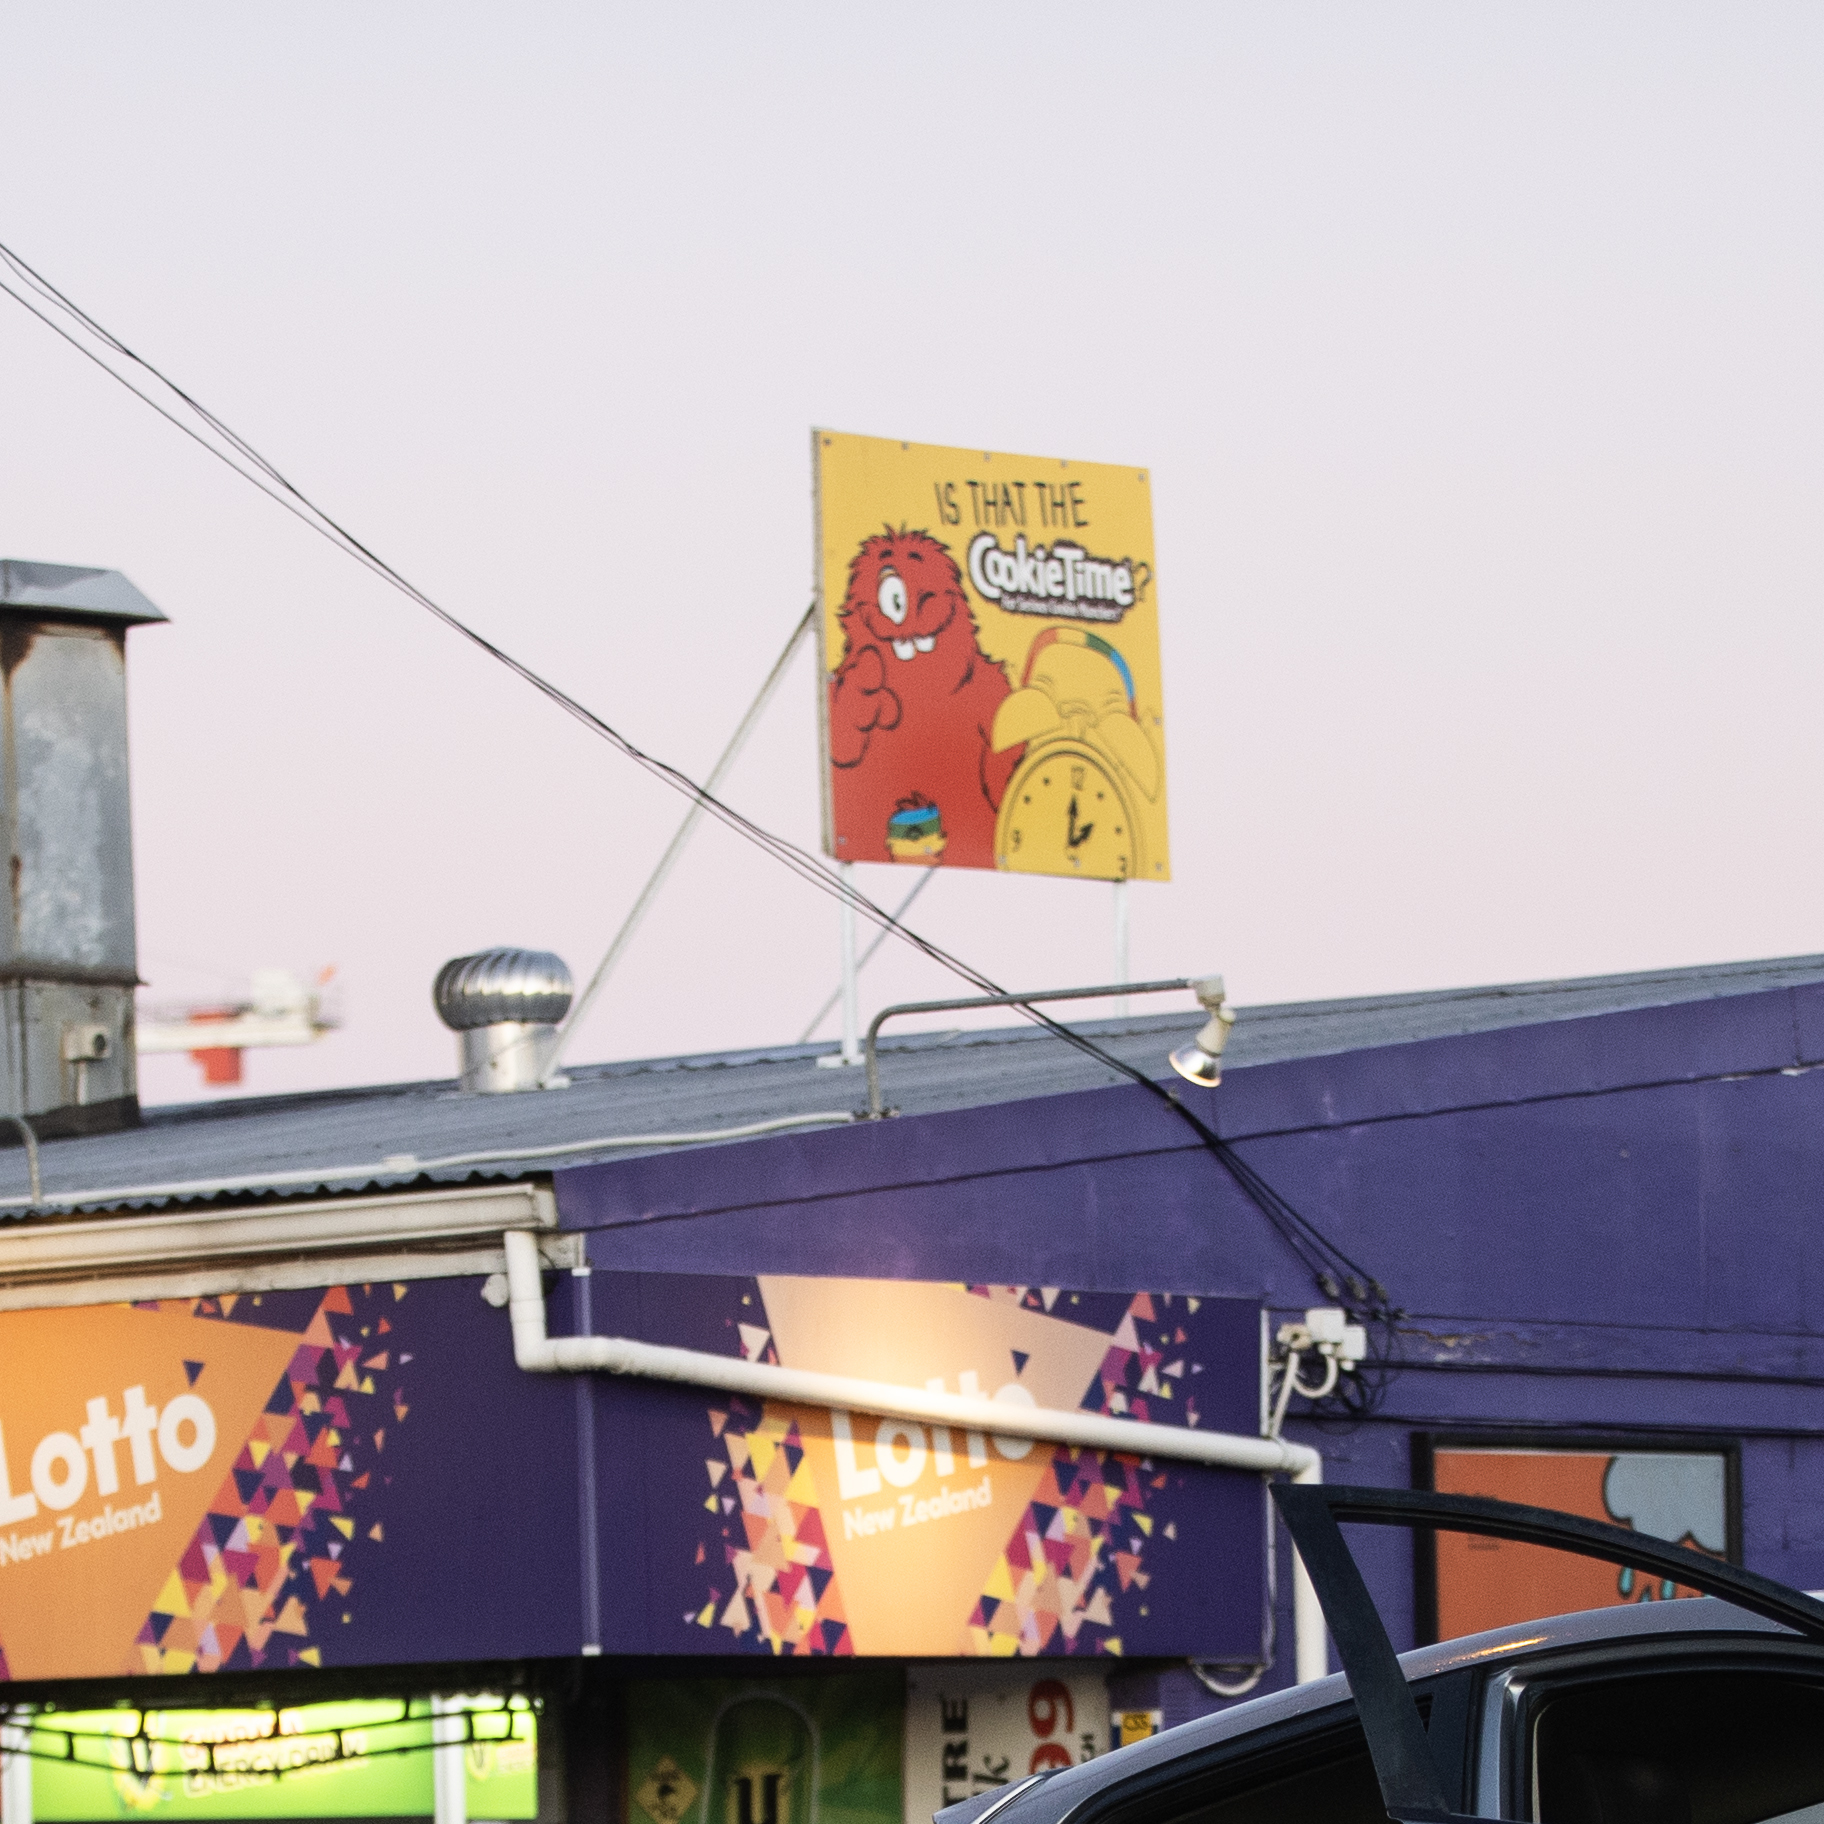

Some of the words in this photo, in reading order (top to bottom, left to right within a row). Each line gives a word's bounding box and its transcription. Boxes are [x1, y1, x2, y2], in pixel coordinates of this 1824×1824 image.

[934, 480, 961, 527] IS
[966, 480, 1028, 529] THAT
[1034, 480, 1090, 528] THE
[57, 1492, 163, 1547] Zealand
[842, 1502, 898, 1540] New
[901, 1476, 992, 1528] Zealand
